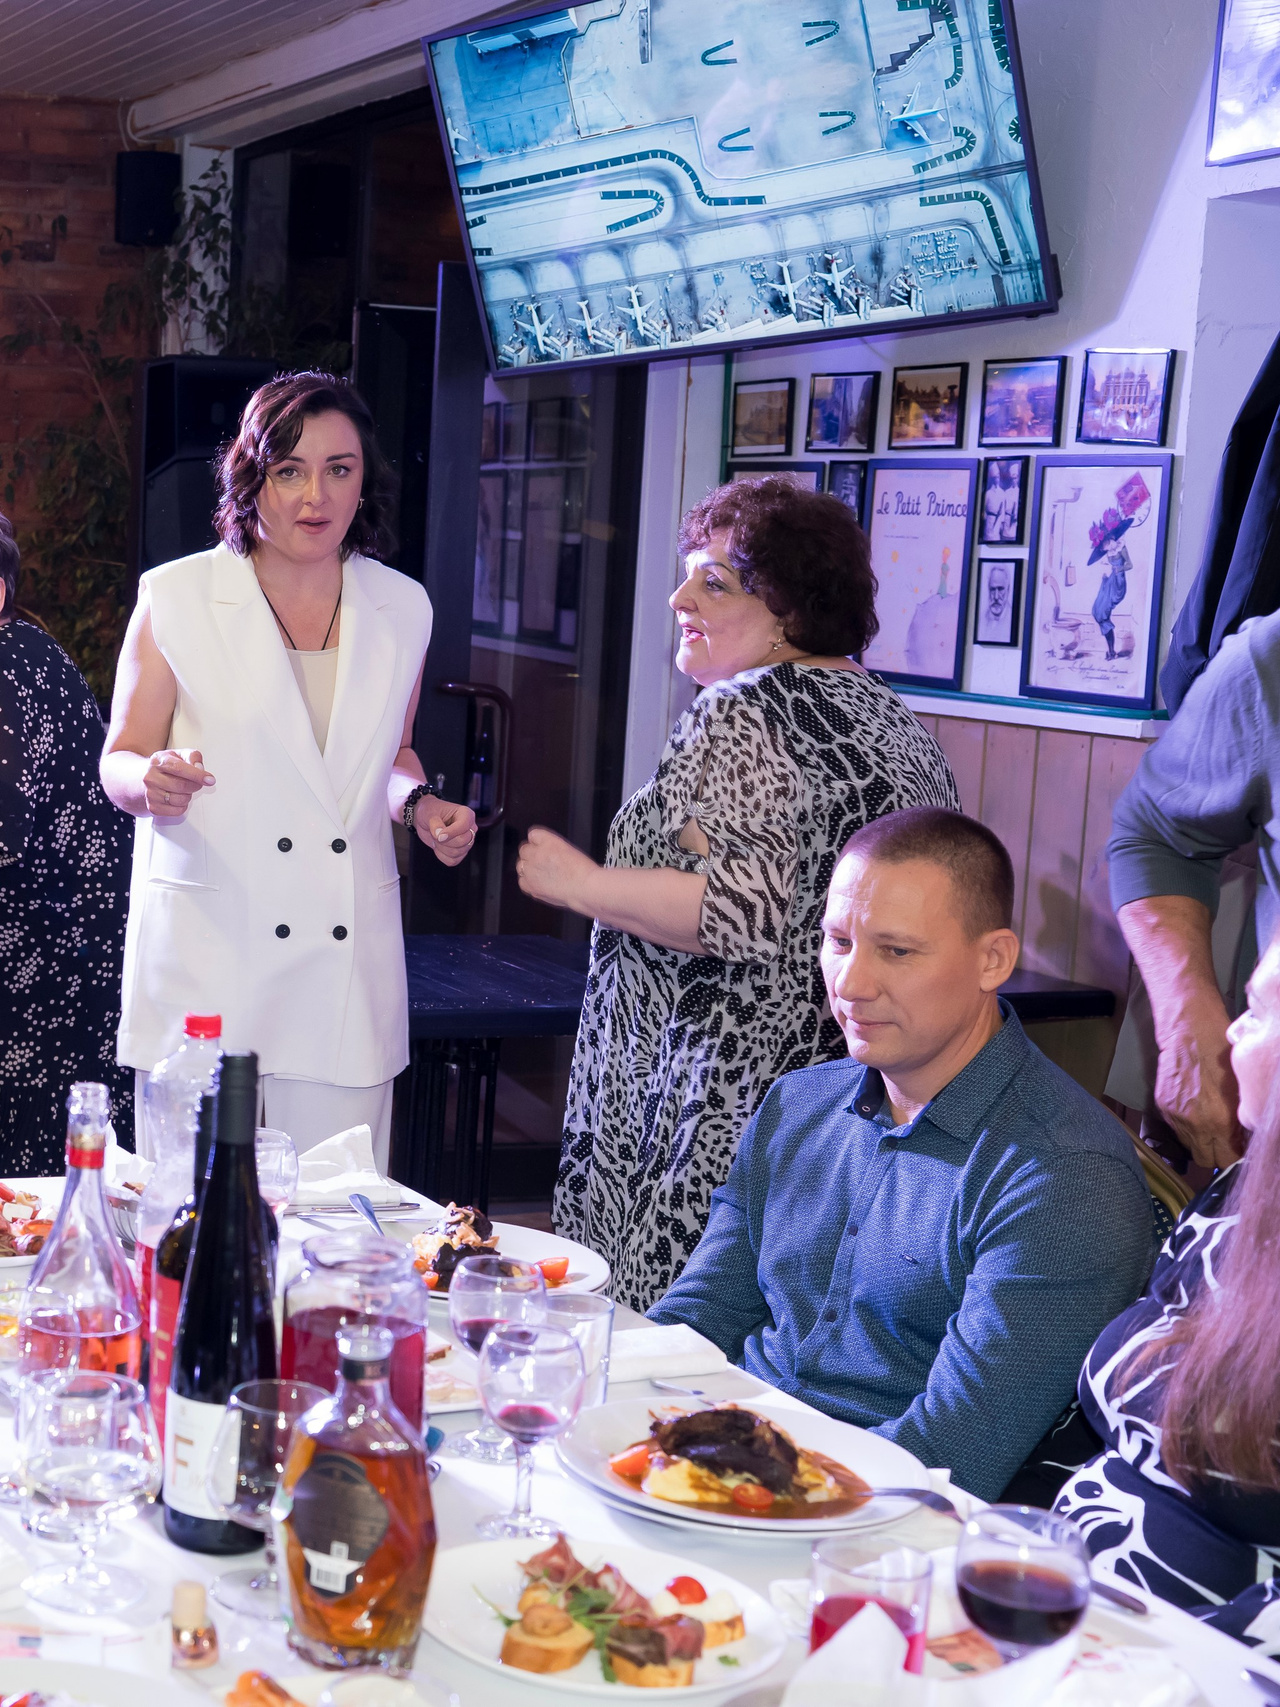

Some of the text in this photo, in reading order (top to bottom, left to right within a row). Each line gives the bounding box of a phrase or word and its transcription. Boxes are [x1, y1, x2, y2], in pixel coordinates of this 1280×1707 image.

[876, 491, 967, 518] Le Petit Prince
[172, 1433, 194, 1486] F
